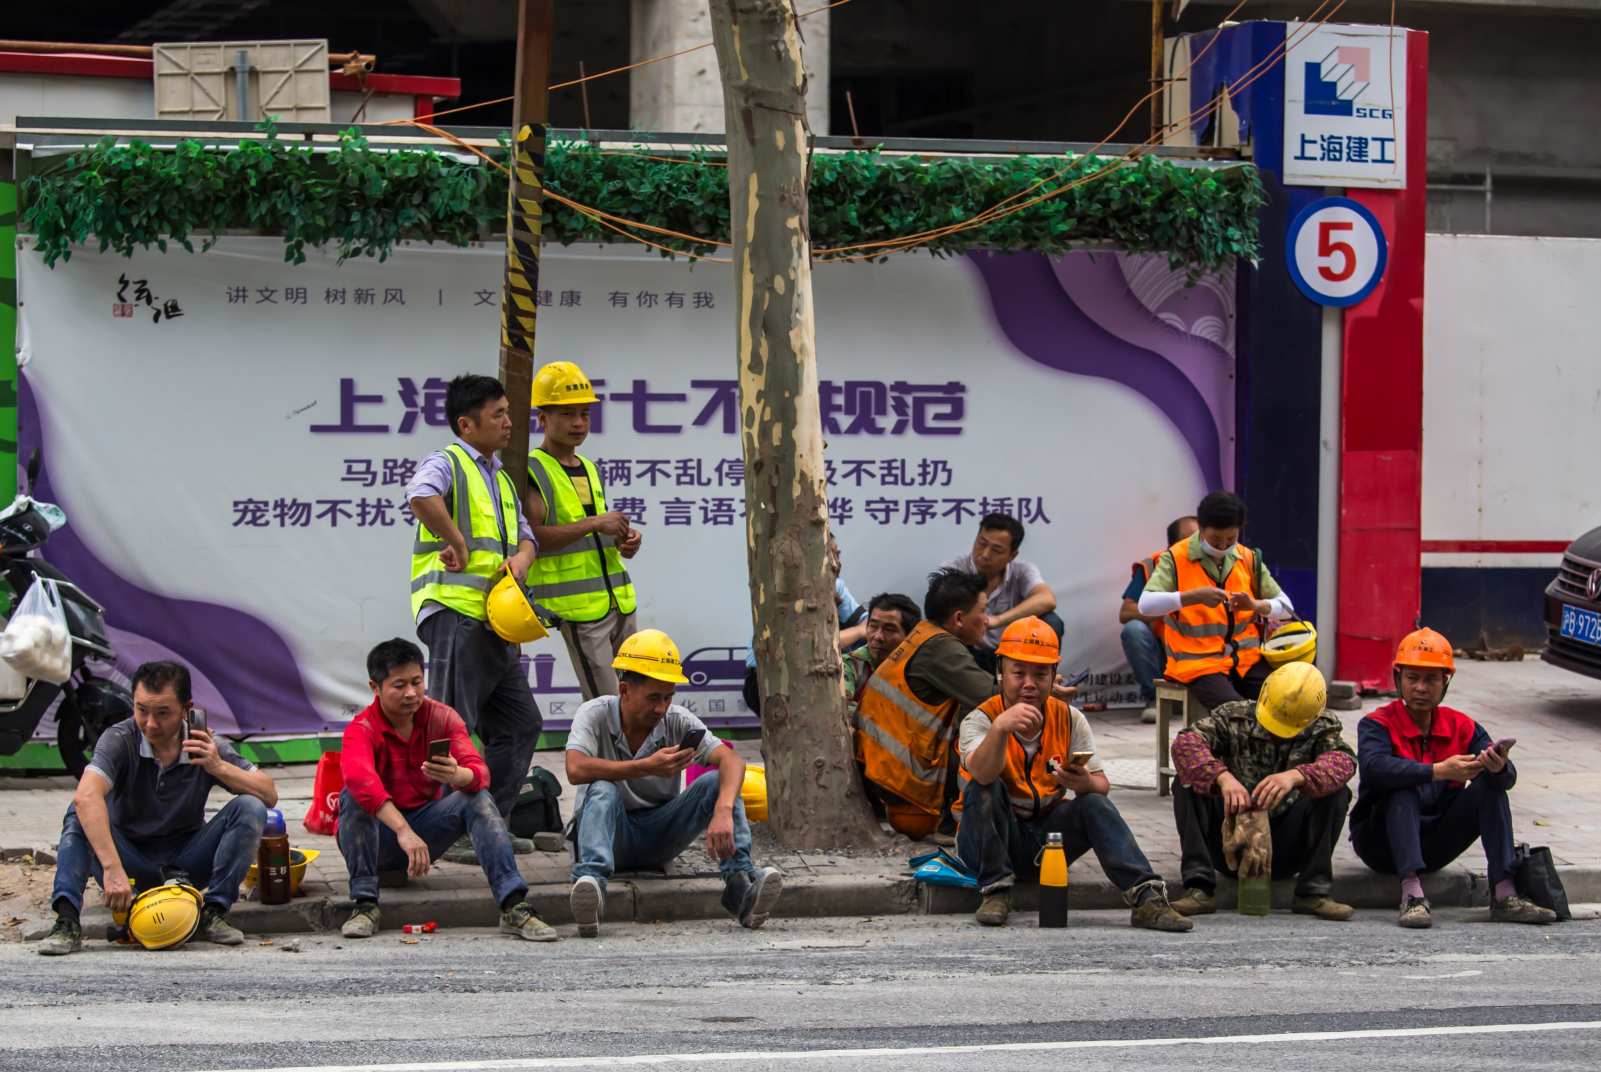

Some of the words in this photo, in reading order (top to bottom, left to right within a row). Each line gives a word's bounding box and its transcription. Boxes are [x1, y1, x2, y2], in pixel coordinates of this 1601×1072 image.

[1355, 107, 1394, 119] SCG
[1293, 133, 1396, 165] 上海建工
[1317, 221, 1358, 283] 5
[226, 286, 309, 305] 讲文明
[324, 286, 406, 306] 树新风
[473, 288, 582, 308] 文健康
[608, 290, 715, 309] 有你有我
